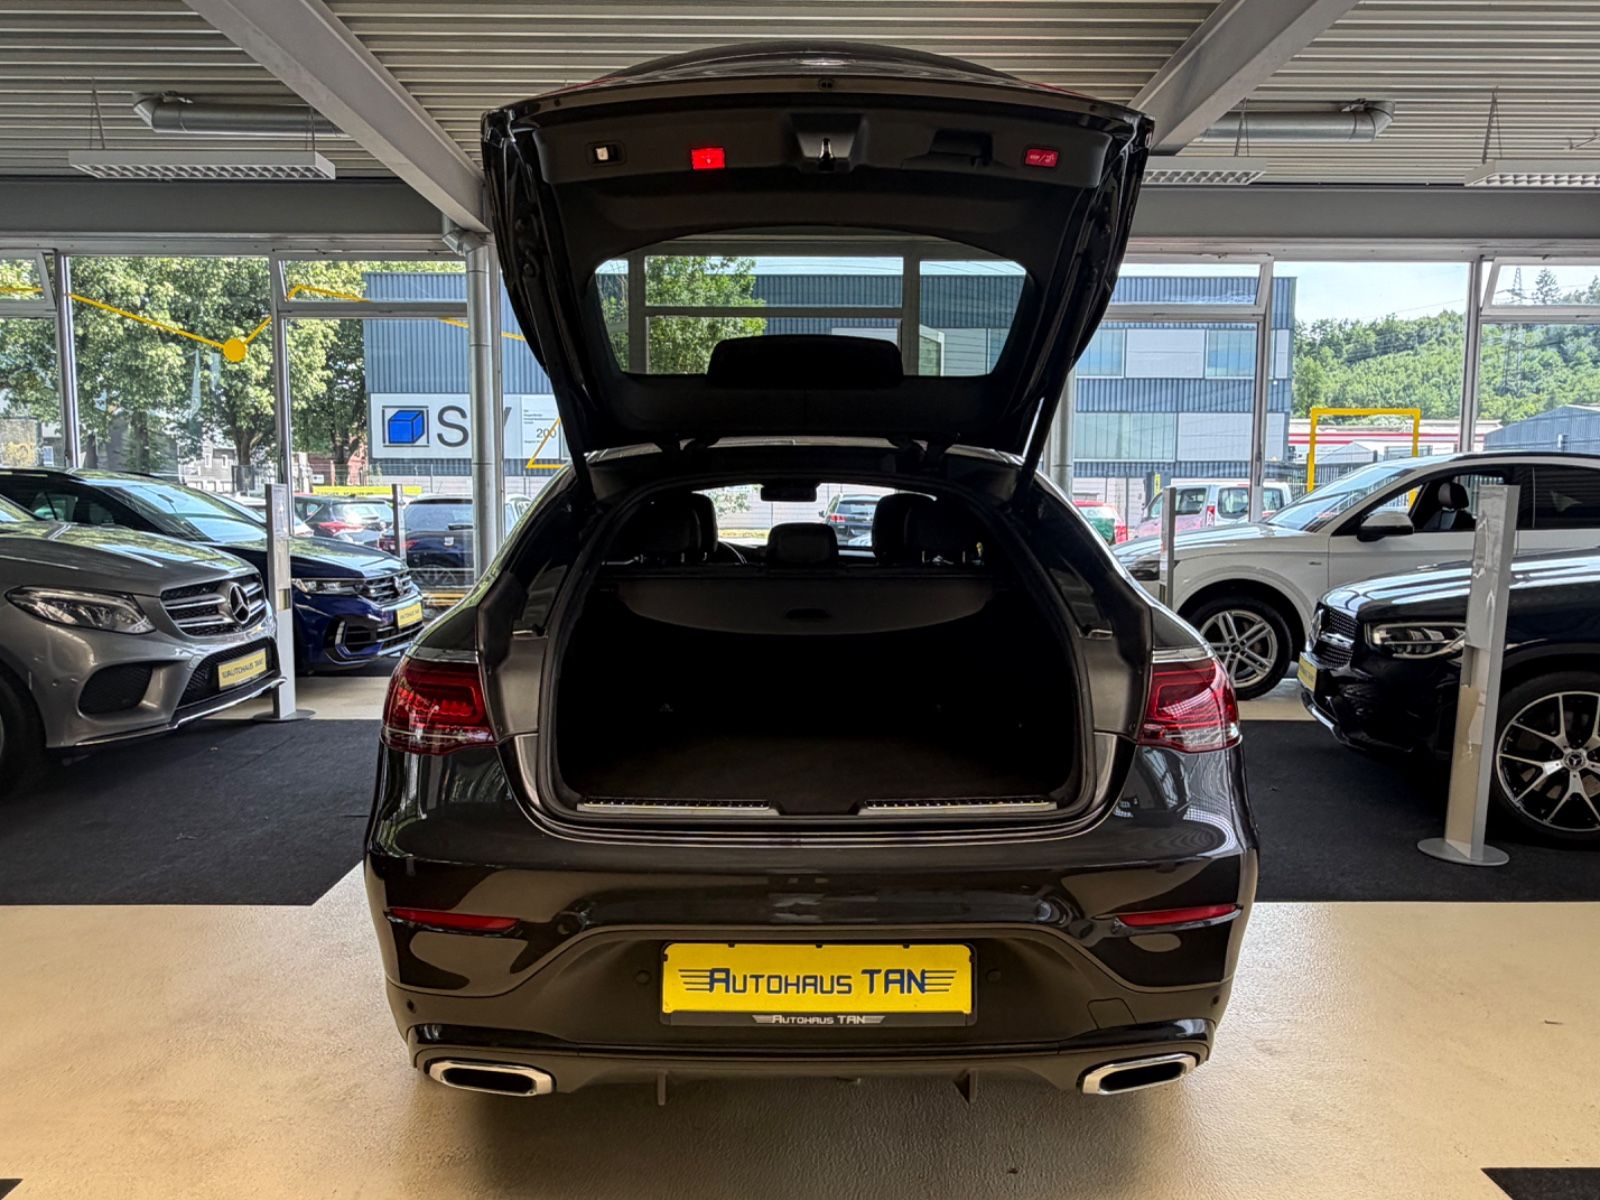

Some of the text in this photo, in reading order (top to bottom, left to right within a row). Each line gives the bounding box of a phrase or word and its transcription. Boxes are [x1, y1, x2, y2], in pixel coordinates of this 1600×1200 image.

[709, 967, 926, 995] AUTOHAUS TAN
[771, 1014, 866, 1025] AUTOHAUS TAN
